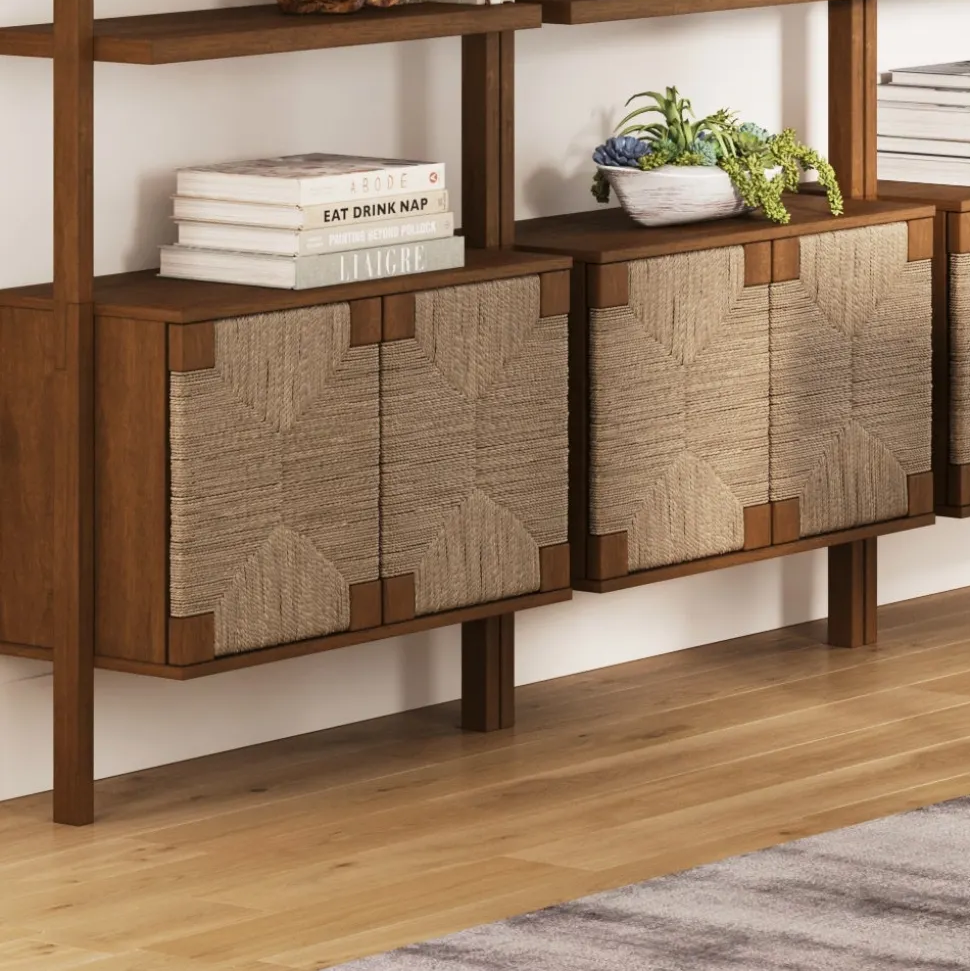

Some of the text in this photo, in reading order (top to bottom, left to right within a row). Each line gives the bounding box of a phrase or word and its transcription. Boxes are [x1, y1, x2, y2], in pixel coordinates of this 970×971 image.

[350, 173, 409, 194] ABODE
[323, 197, 429, 223] EAT DRINK NAP
[340, 245, 425, 281] LIAIGRE
